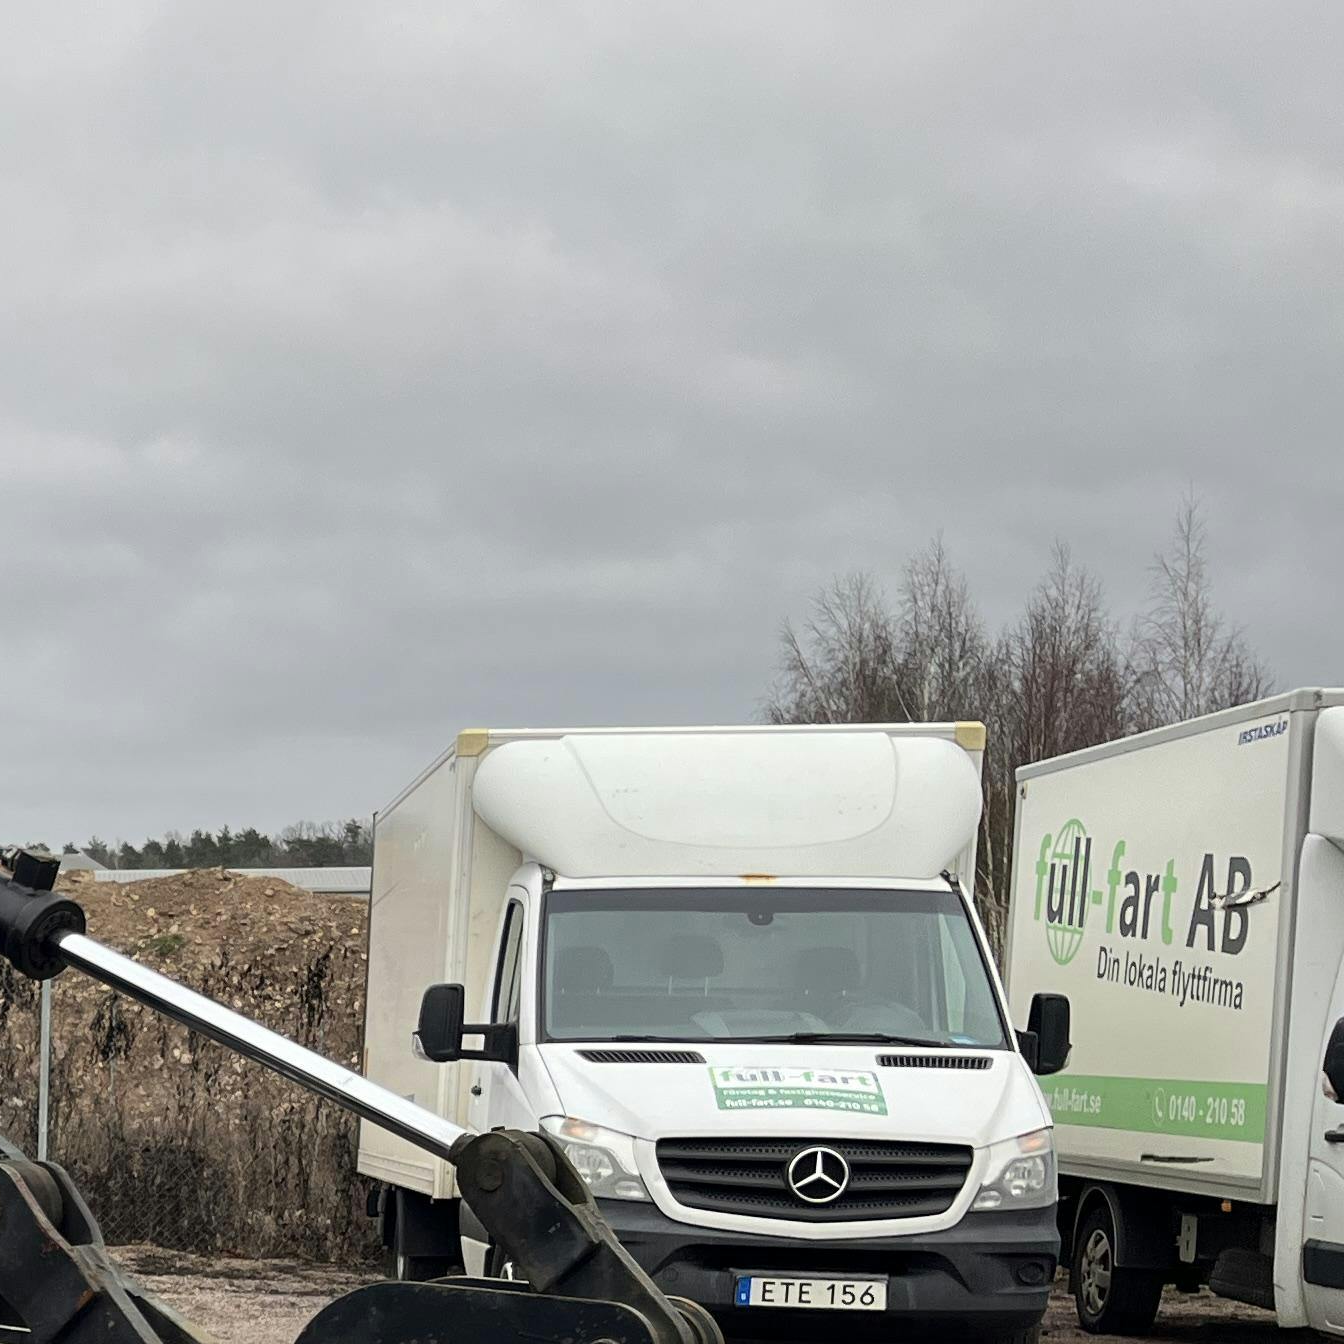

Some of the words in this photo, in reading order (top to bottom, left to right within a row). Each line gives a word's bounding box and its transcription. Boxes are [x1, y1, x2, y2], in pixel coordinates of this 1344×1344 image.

[1033, 833, 1178, 946] full-fart
[1186, 853, 1253, 956] AB
[1097, 946, 1120, 984] Din
[1123, 951, 1166, 993] lokala
[1171, 960, 1244, 1010] flyttfirma
[720, 1070, 872, 1087] full-fart
[1168, 1095, 1196, 1122] 0140
[1206, 1097, 1228, 1125] 210
[1230, 1098, 1246, 1126] 58
[761, 1281, 812, 1304] ETE
[826, 1283, 875, 1306] 156
